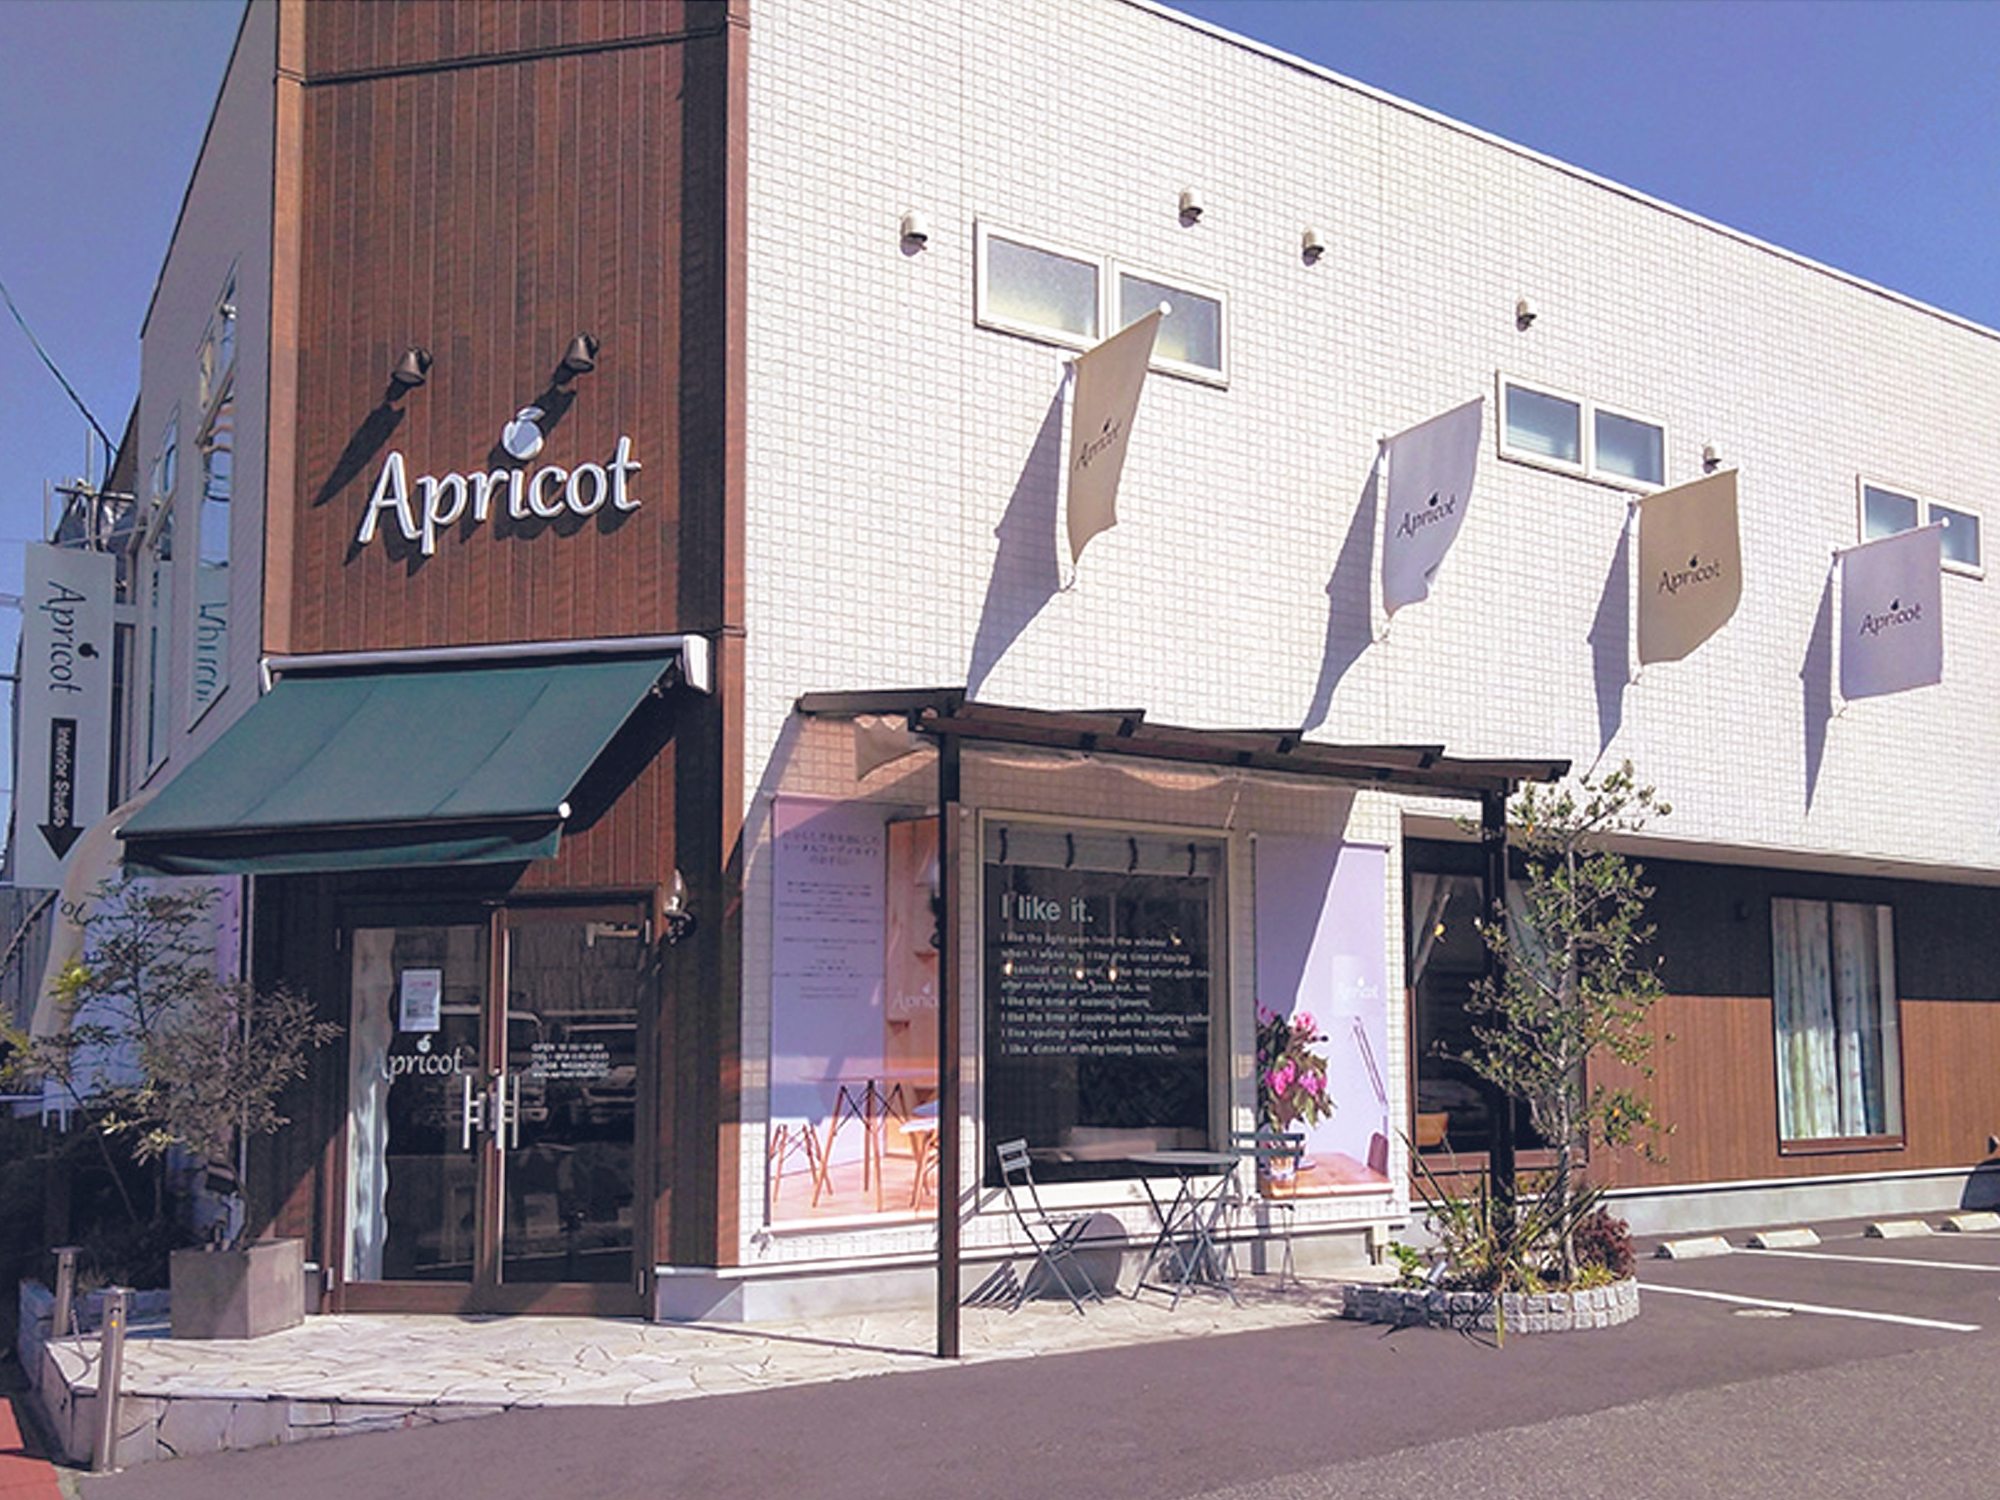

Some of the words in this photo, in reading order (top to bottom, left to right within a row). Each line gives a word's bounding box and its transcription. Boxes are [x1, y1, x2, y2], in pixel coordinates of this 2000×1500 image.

[1075, 418, 1122, 471] Apricot
[359, 436, 642, 555] Apricot
[1396, 493, 1456, 539] Apricot
[1657, 558, 1721, 595] Apricot
[39, 581, 86, 694] Apricot
[1859, 603, 1922, 637] Apricot
[54, 726, 73, 778] Interior
[53, 779, 72, 829] Studio
[1001, 894, 1008, 919] I
[1018, 896, 1061, 921] like
[1071, 897, 1094, 923] it.
